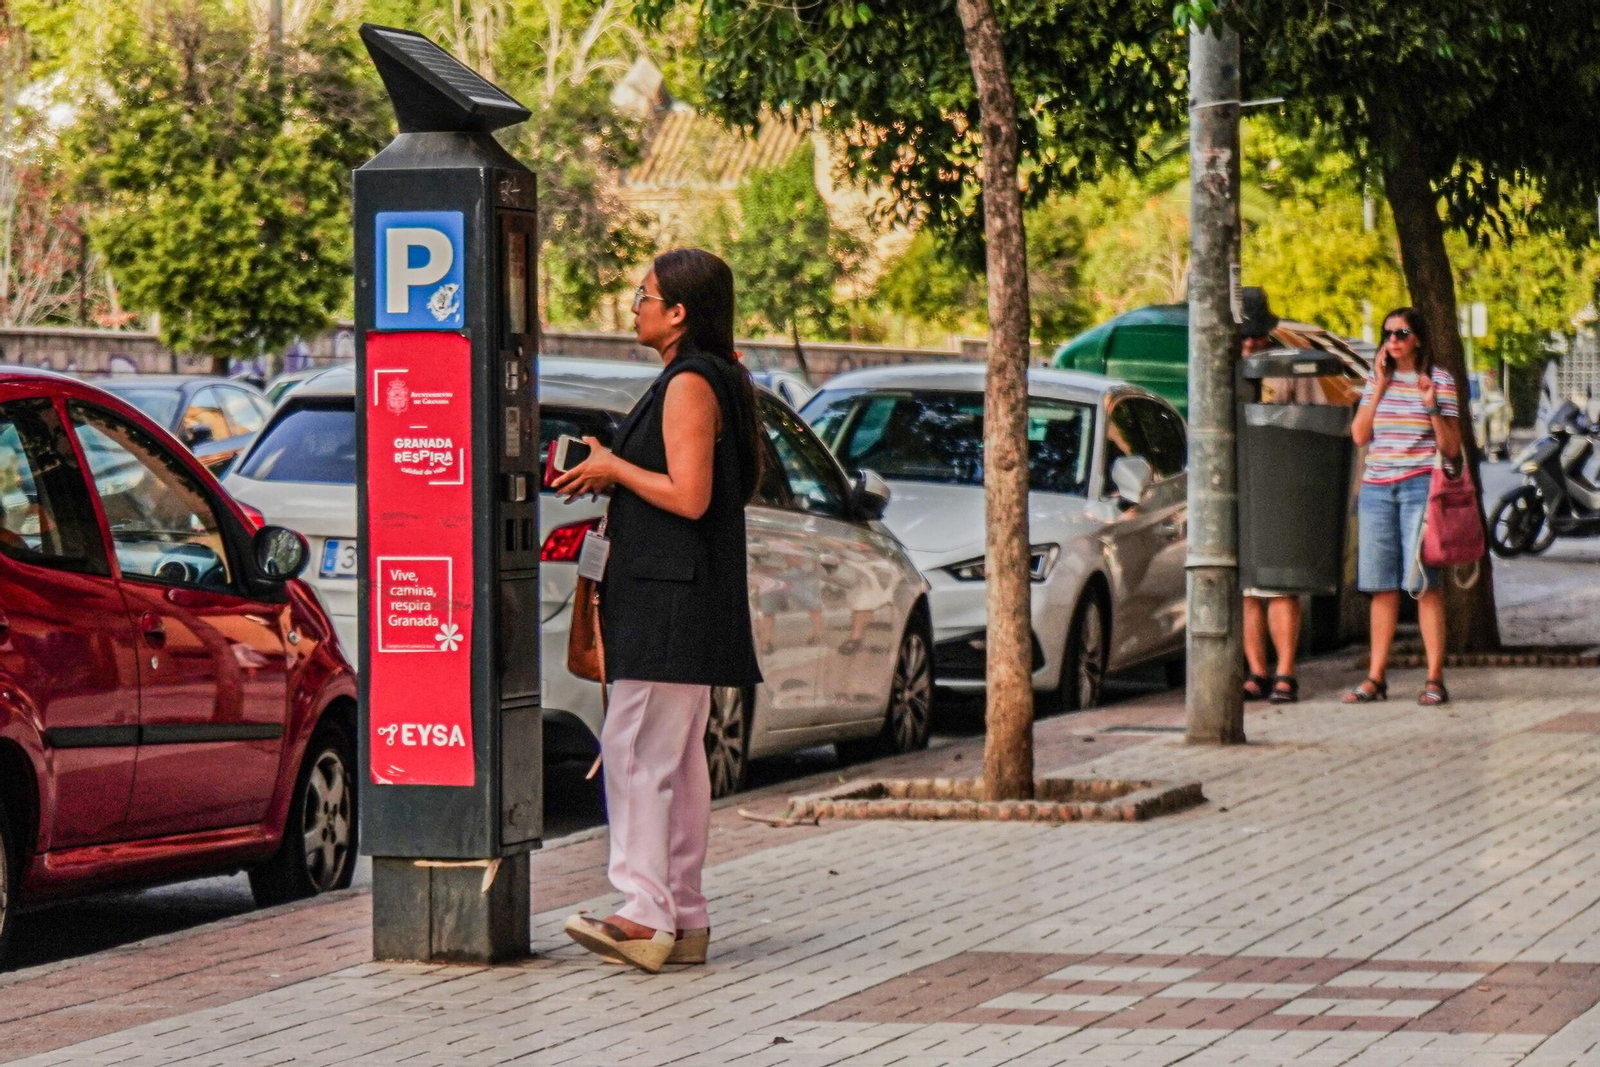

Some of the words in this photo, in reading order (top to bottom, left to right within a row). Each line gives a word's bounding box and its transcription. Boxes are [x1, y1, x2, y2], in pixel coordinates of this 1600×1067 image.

[386, 228, 453, 313] P
[394, 438, 453, 448] GRANADA
[401, 467, 424, 475] calidad
[390, 569, 418, 582] Vive,
[390, 585, 437, 598] camina,
[391, 600, 431, 613] respira
[388, 614, 439, 627] Granada
[401, 723, 466, 747] EYSA
